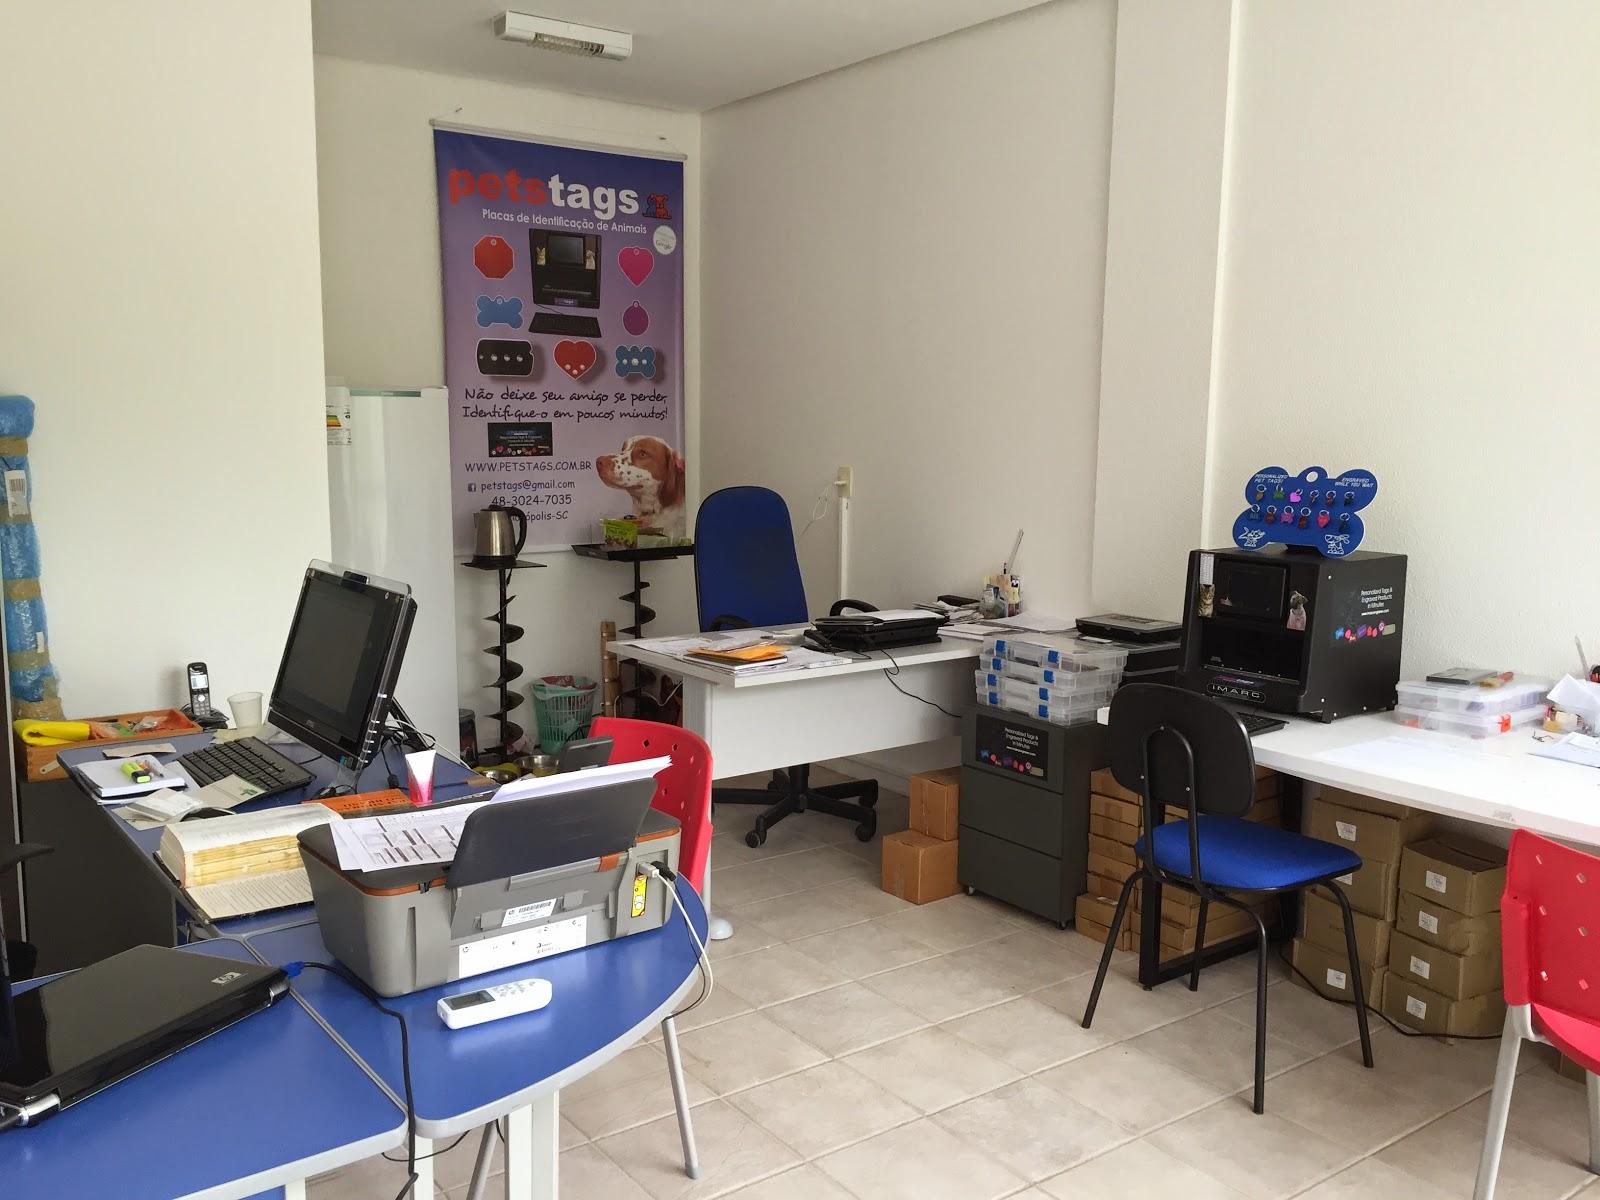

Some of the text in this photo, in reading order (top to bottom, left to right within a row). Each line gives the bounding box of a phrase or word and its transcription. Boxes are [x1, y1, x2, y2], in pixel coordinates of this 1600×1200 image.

[448, 167, 640, 220] petstags
[482, 208, 647, 235] Placas de Identificação de Animais
[465, 388, 494, 400] Não
[500, 385, 537, 401] deixe
[542, 390, 565, 403] seu
[570, 390, 609, 406] amigo
[614, 392, 627, 403] se
[462, 403, 668, 423] Identifique-o em poucos minutos!
[464, 460, 592, 472] WWW.PETSTAGS.COM.BR
[480, 480, 575, 493] petstags@gmail.com
[491, 494, 572, 506] 48-3024-7035
[1212, 685, 1260, 698] IMARC
